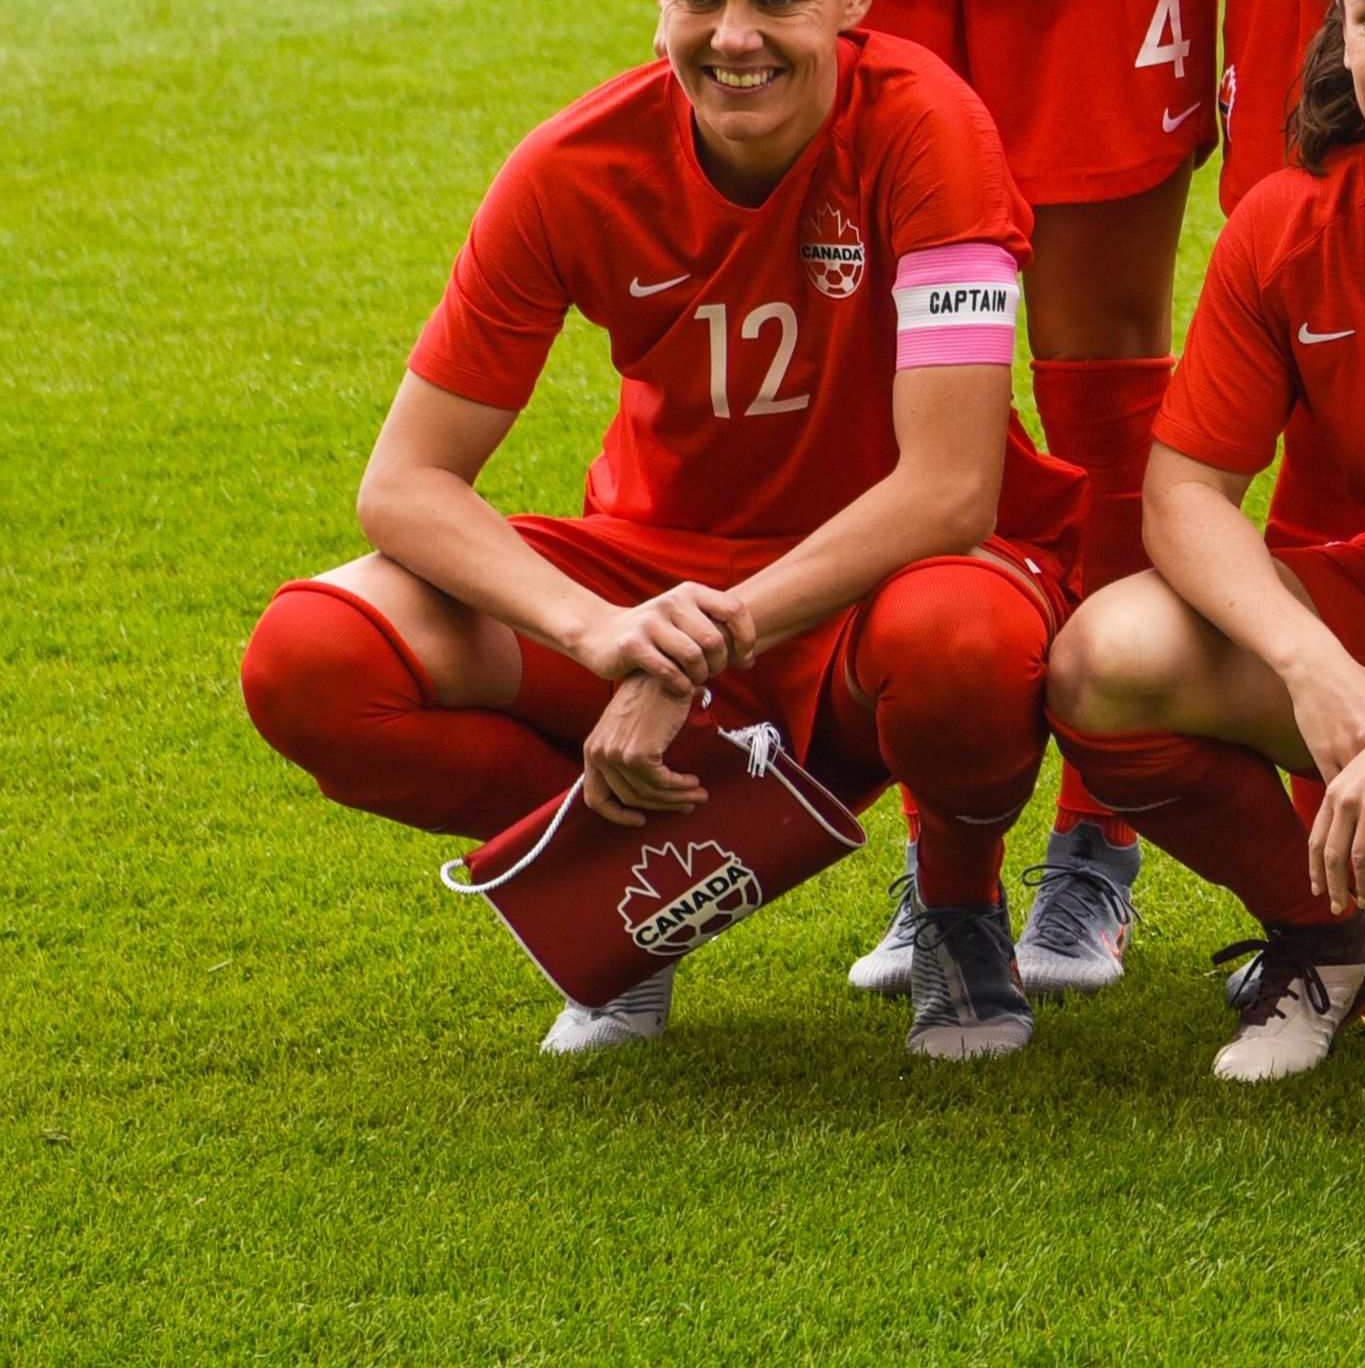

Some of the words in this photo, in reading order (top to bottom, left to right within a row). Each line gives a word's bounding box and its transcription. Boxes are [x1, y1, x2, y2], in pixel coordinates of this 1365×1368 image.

[802, 245, 862, 261] CANADA
[930, 289, 1006, 314] CAPTAIN
[694, 302, 810, 419] 12
[636, 865, 750, 946] CANADA
